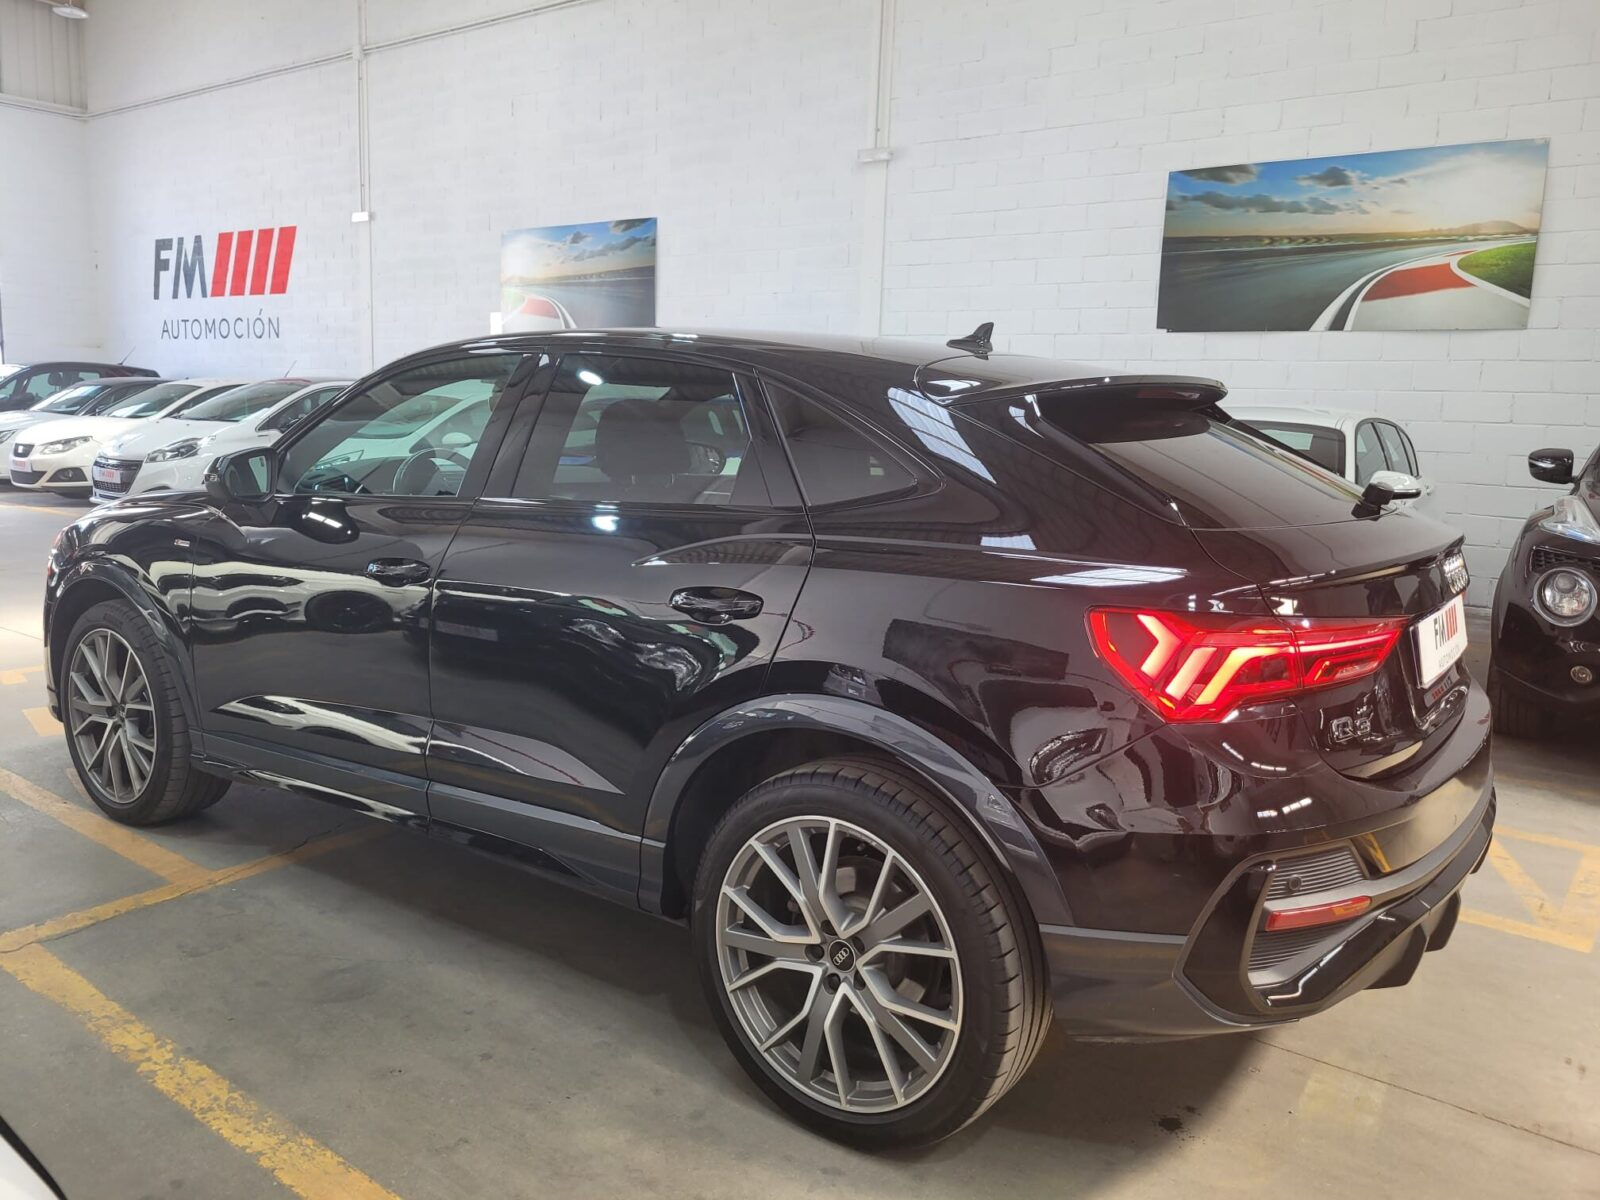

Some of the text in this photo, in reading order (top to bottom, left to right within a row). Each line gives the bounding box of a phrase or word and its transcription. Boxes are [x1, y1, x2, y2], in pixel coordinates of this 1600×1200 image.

[153, 235, 208, 300] FM
[161, 308, 280, 340] AUTOMOCIÓN
[1331, 716, 1371, 743] Q3
